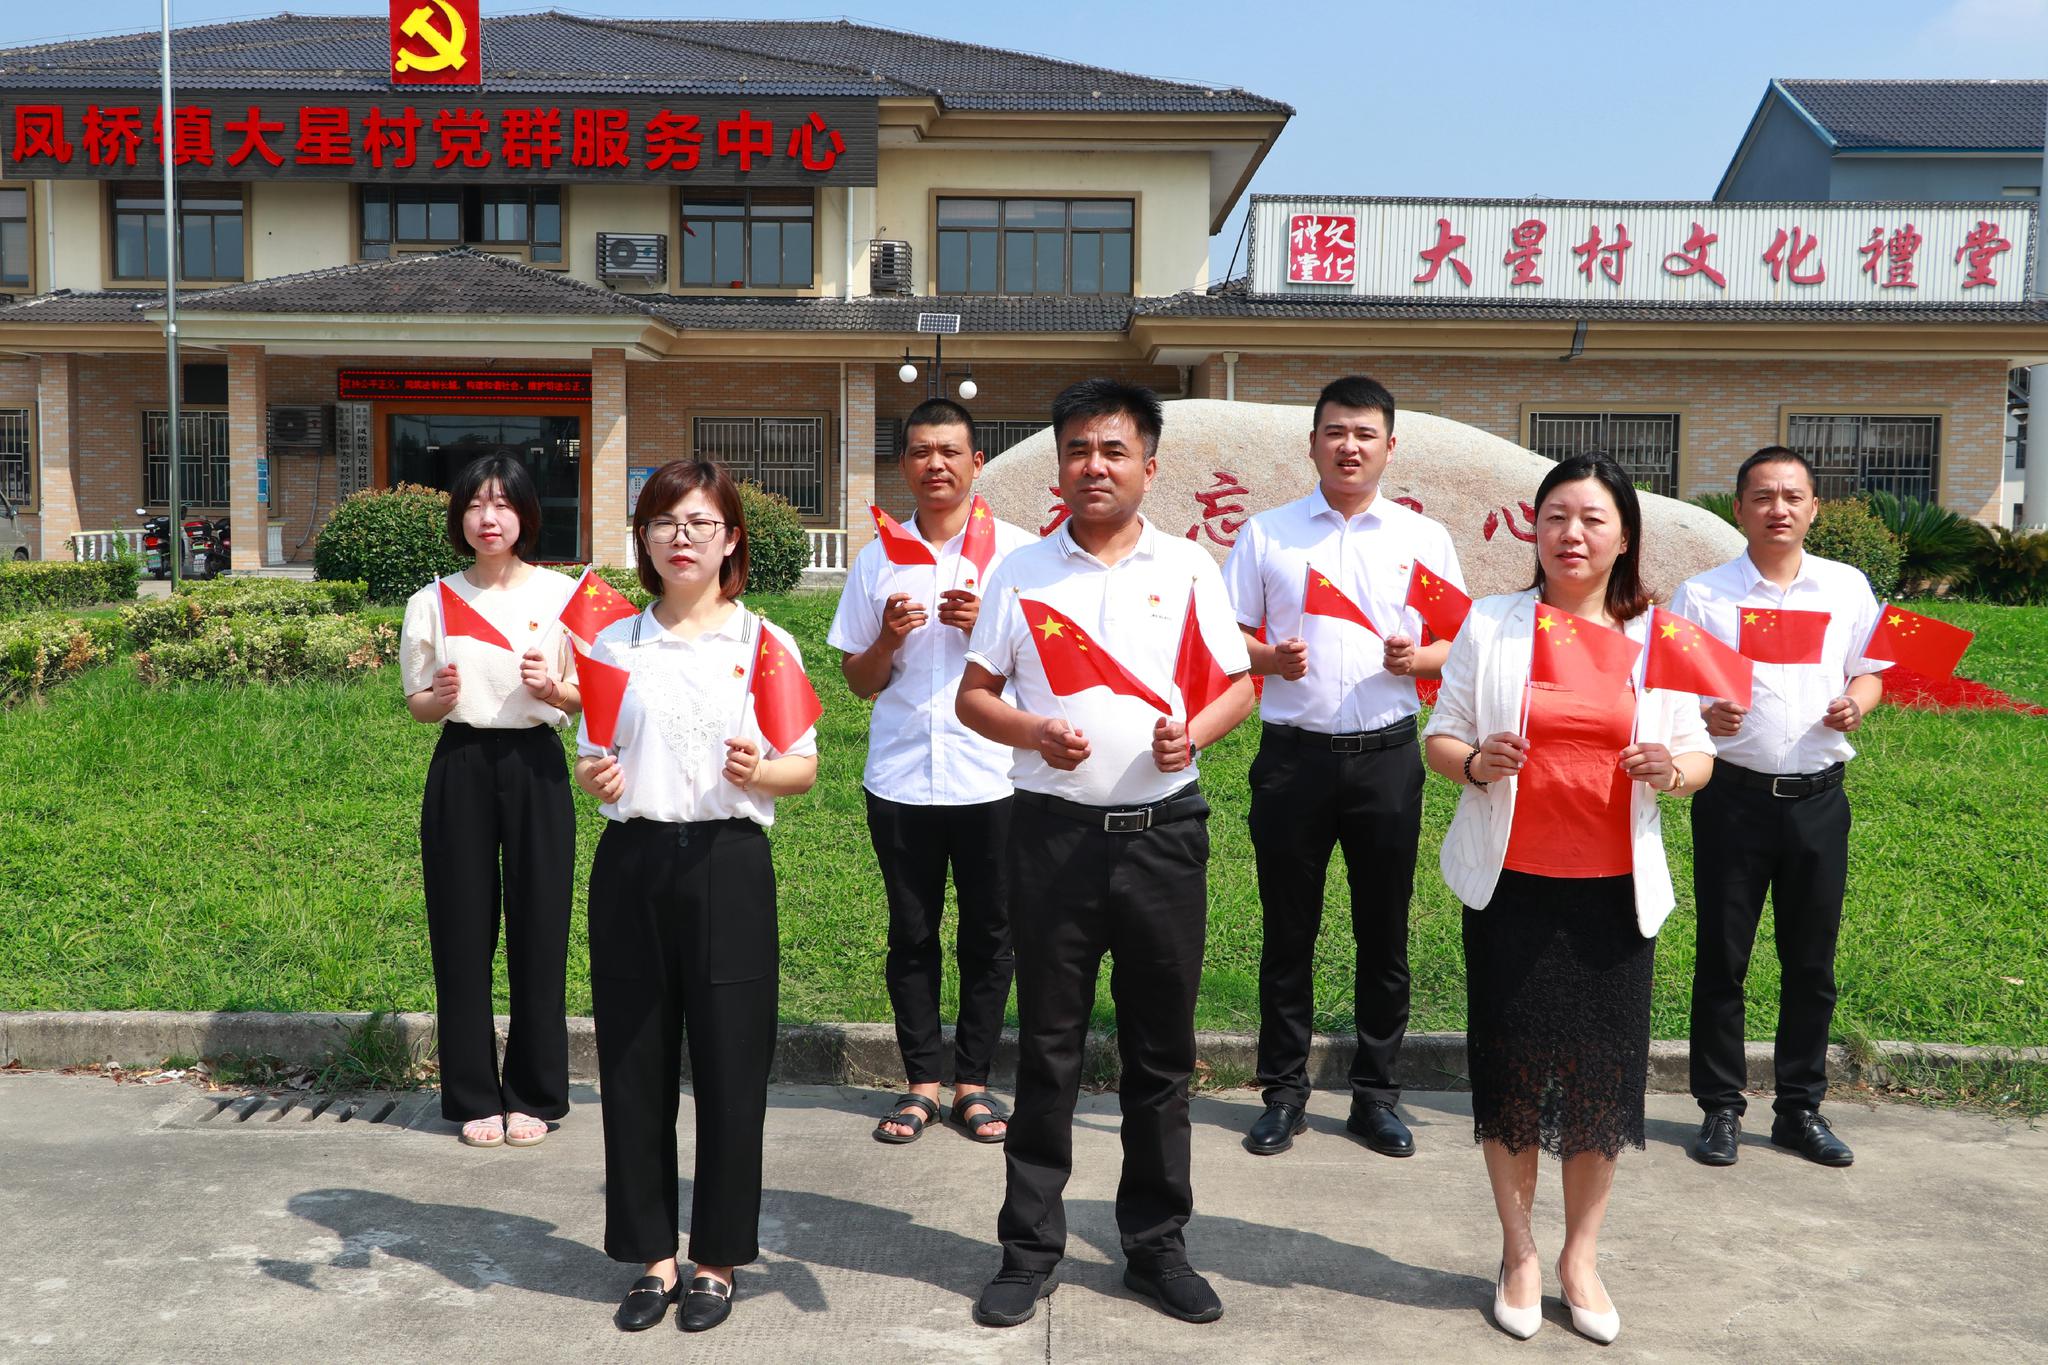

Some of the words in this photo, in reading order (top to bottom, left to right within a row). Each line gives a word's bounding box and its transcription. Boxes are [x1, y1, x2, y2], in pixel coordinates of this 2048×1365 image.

[12, 104, 846, 172] 凤桥镇大星村党群服务中心
